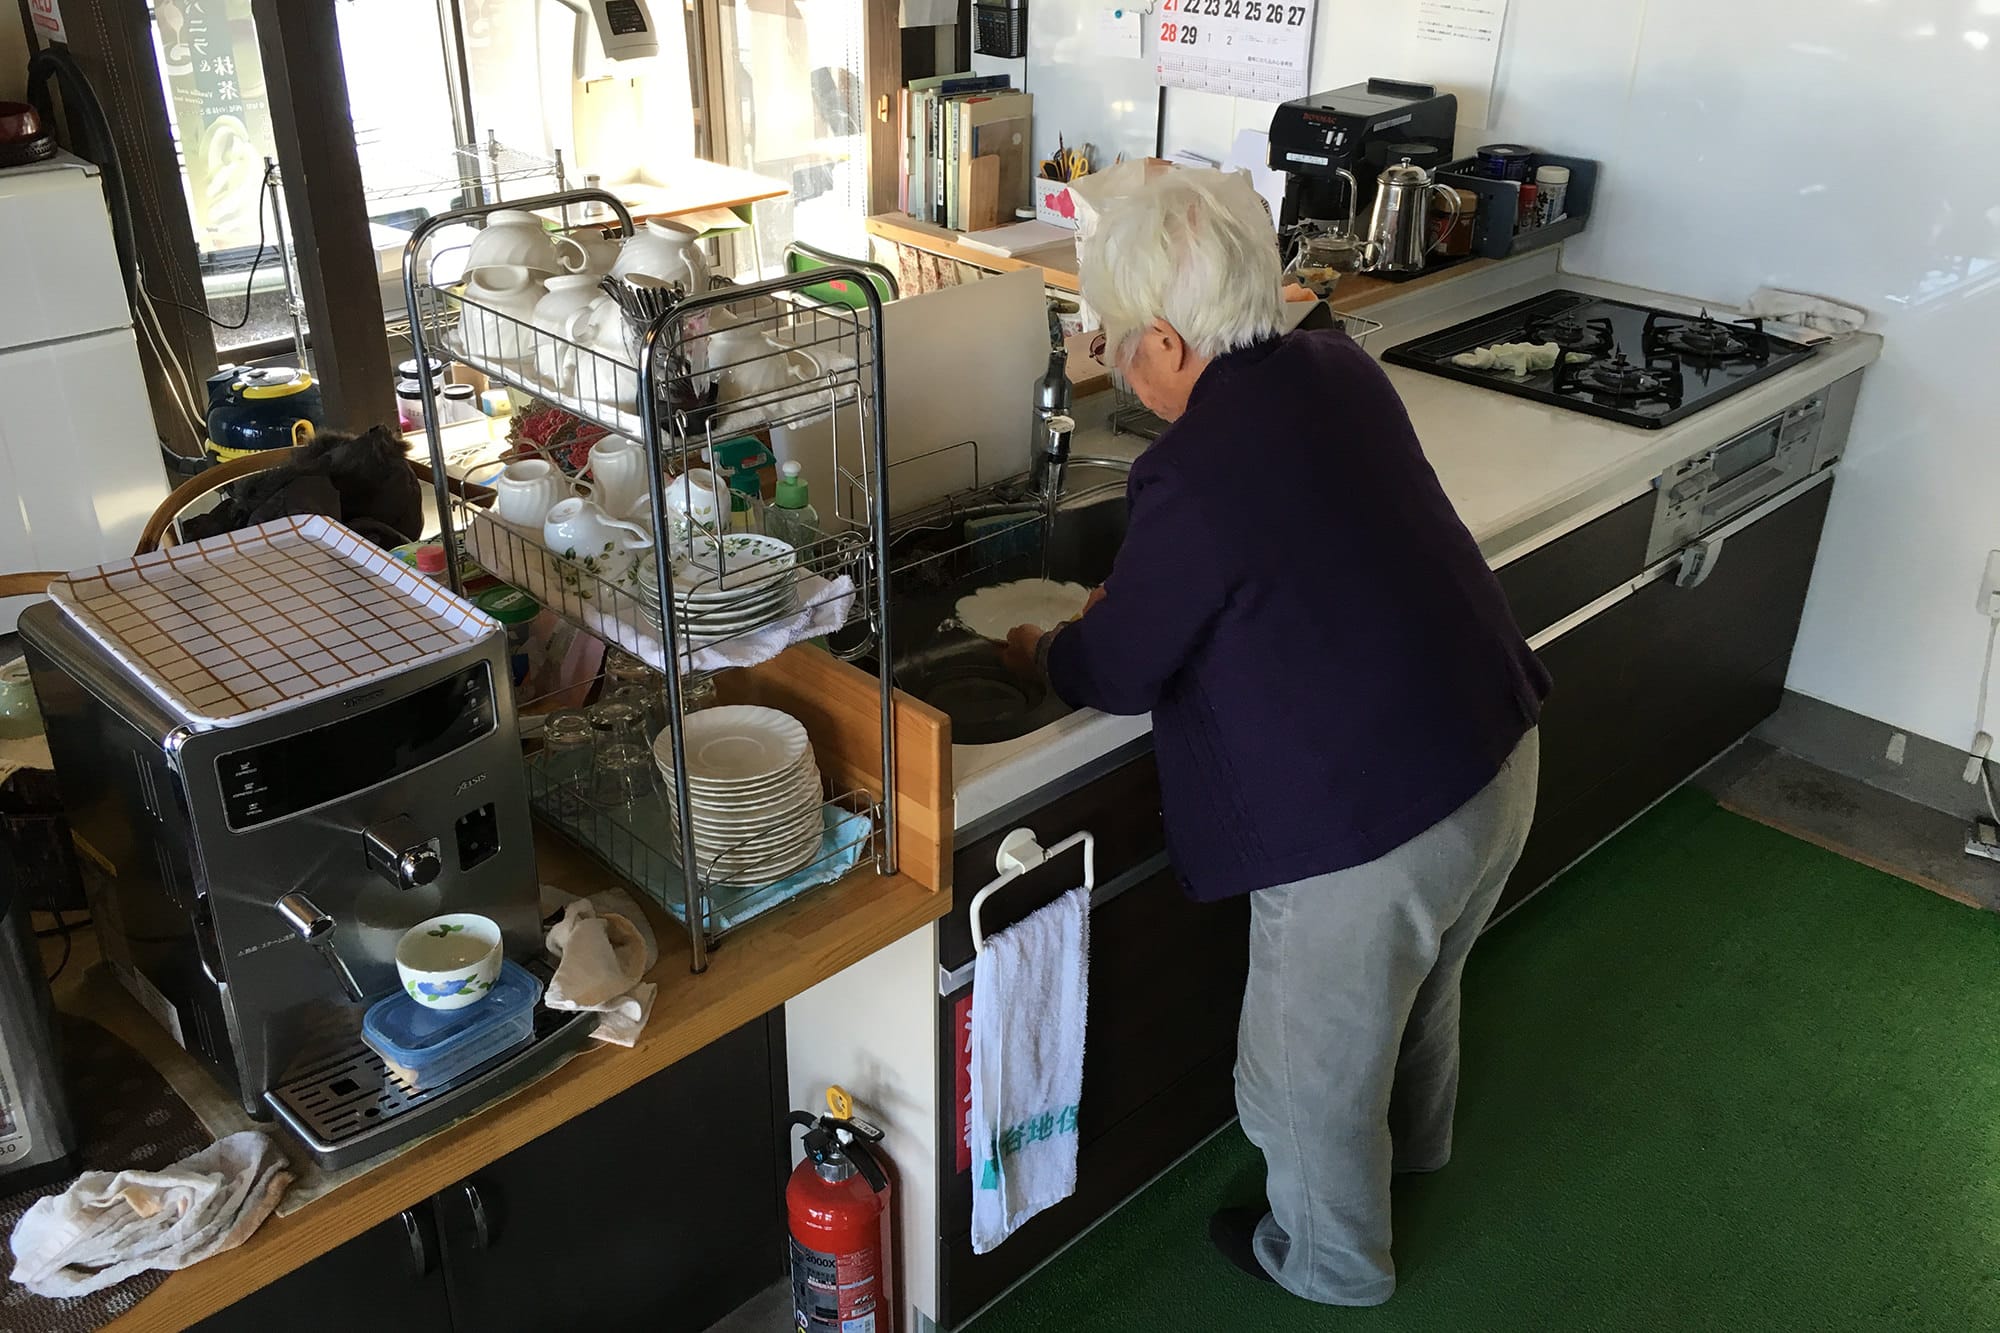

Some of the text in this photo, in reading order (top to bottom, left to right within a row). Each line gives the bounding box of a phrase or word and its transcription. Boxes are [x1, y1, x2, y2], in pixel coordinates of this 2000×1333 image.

[1163, 0, 1306, 27] 21 22 23 24 25 26 27
[1160, 23, 1178, 43] 28
[1181, 25, 1198, 45] 29
[1226, 35, 1233, 46] 2
